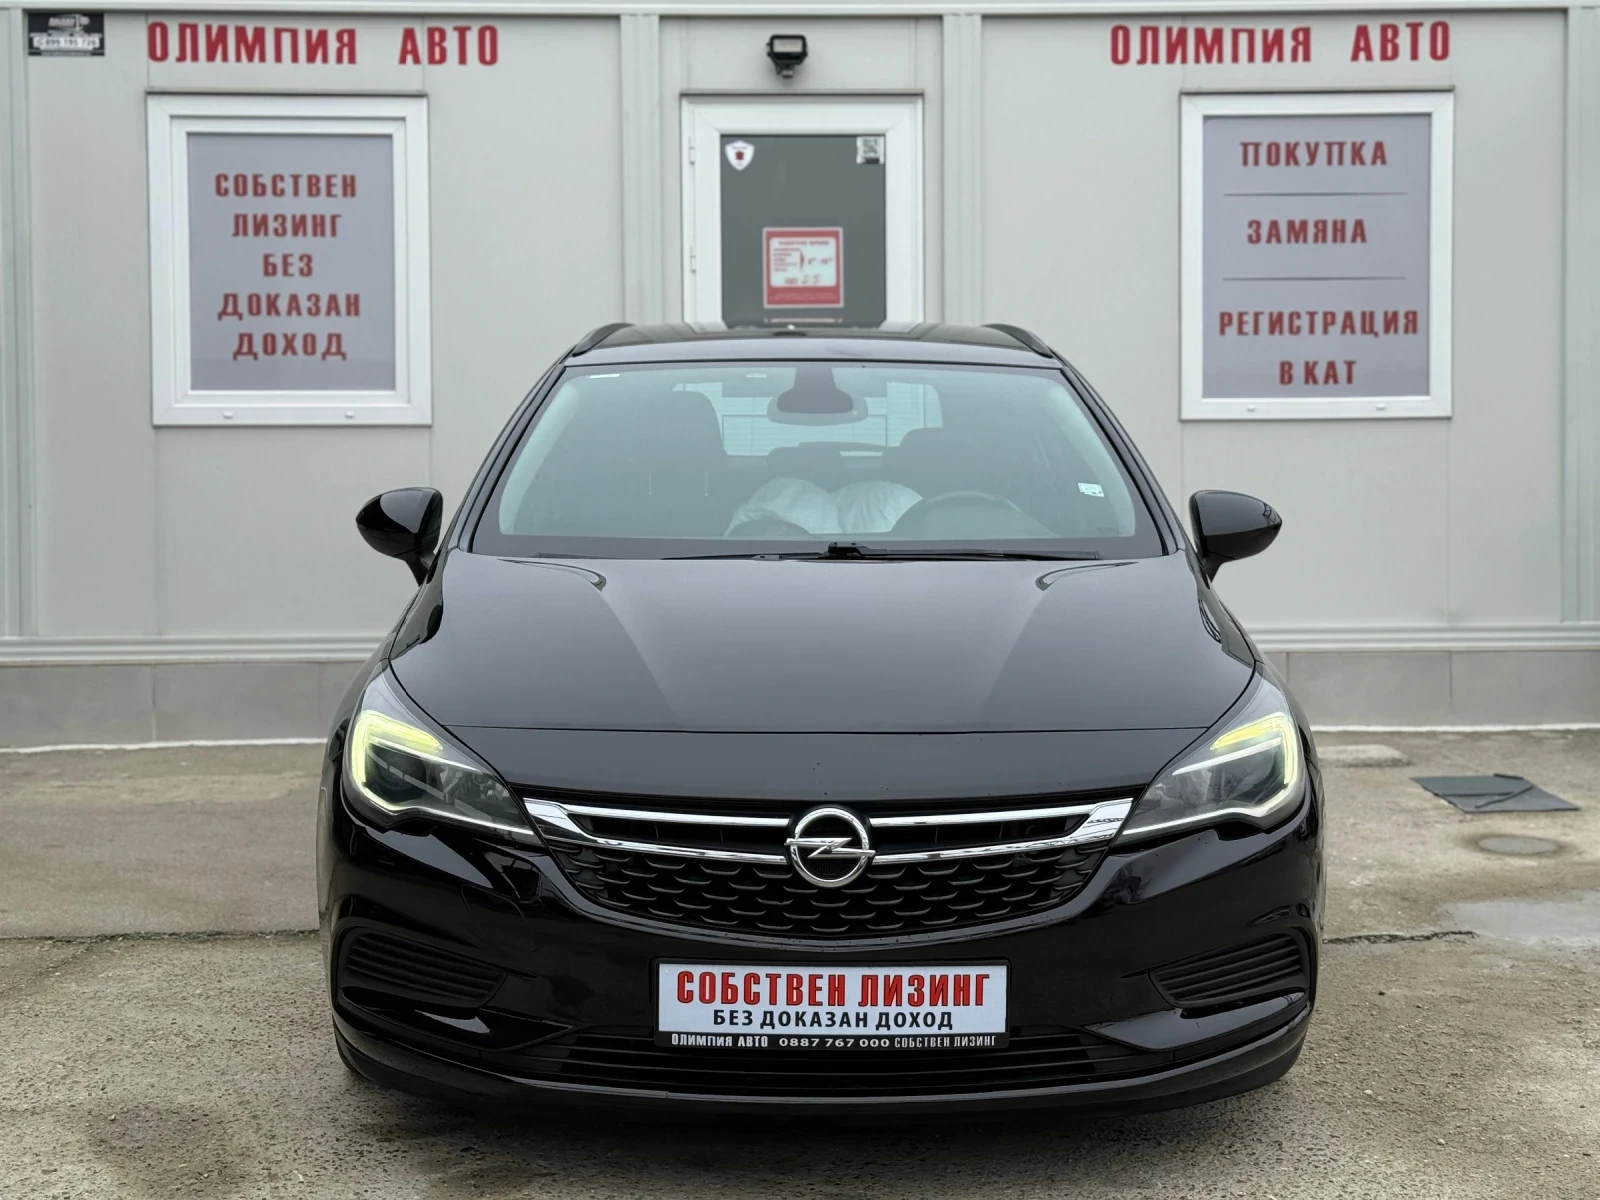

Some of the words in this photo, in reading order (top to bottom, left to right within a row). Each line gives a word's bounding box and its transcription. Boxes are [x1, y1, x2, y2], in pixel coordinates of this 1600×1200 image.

[147, 21, 357, 65] ОЛИМПИЯ
[398, 25, 499, 66] АВТО
[1110, 24, 1312, 66] ОЛИМПИЯ
[1350, 20, 1451, 62] АВТО
[1240, 141, 1387, 167] ПОКУПКА
[214, 173, 357, 198] СОБСТВЕН
[231, 213, 342, 238] ЛИЗИНГ
[1247, 219, 1367, 245] ЗАМЯНА
[262, 254, 313, 278] БЕЗ
[217, 293, 361, 321] ДОКАЗАН
[1218, 310, 1419, 338] РЕГИСТРАЦИЯ
[232, 332, 347, 361] ДОХОД
[1278, 360, 1294, 386] В
[1303, 359, 1357, 385] КАТ
[676, 970, 846, 1007] СОБСТВЕН
[857, 974, 990, 1007] ЛИЗИНГ
[713, 1009, 753, 1026] БЕЗ
[759, 1010, 868, 1030] ДОКАЗАН
[875, 1011, 953, 1031] ДОХОД
[671, 1032, 733, 1048] ОЛИМПИЯ
[737, 1034, 769, 1048] АВТО
[778, 1036, 820, 1048] 0887
[825, 1037, 855, 1048] 767
[859, 1037, 890, 1049] 000
[893, 1036, 951, 1049] СОБСТВЕН
[953, 1035, 997, 1047] ЛИЗИНГ
